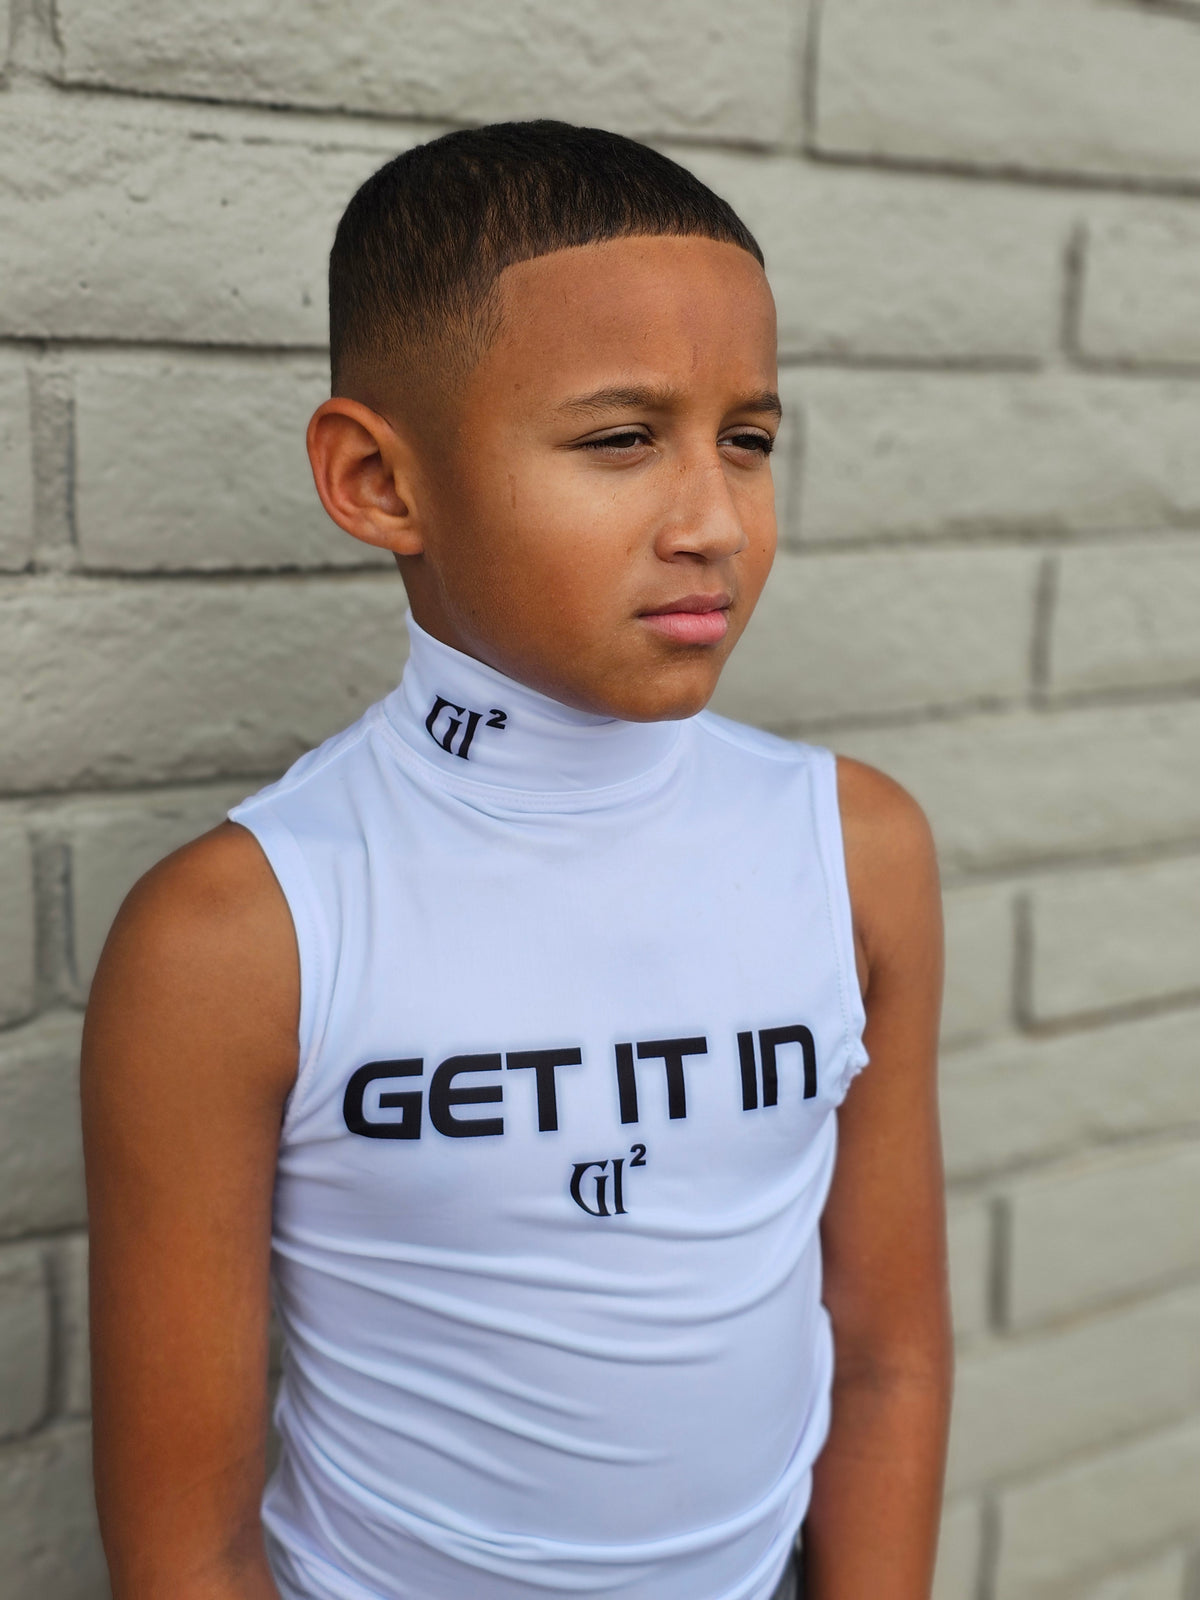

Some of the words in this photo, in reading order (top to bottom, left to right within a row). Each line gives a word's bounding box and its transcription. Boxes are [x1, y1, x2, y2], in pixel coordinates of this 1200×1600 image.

[342, 1047, 583, 1141] GET
[614, 1036, 708, 1125] IT
[736, 1024, 818, 1112] IN
